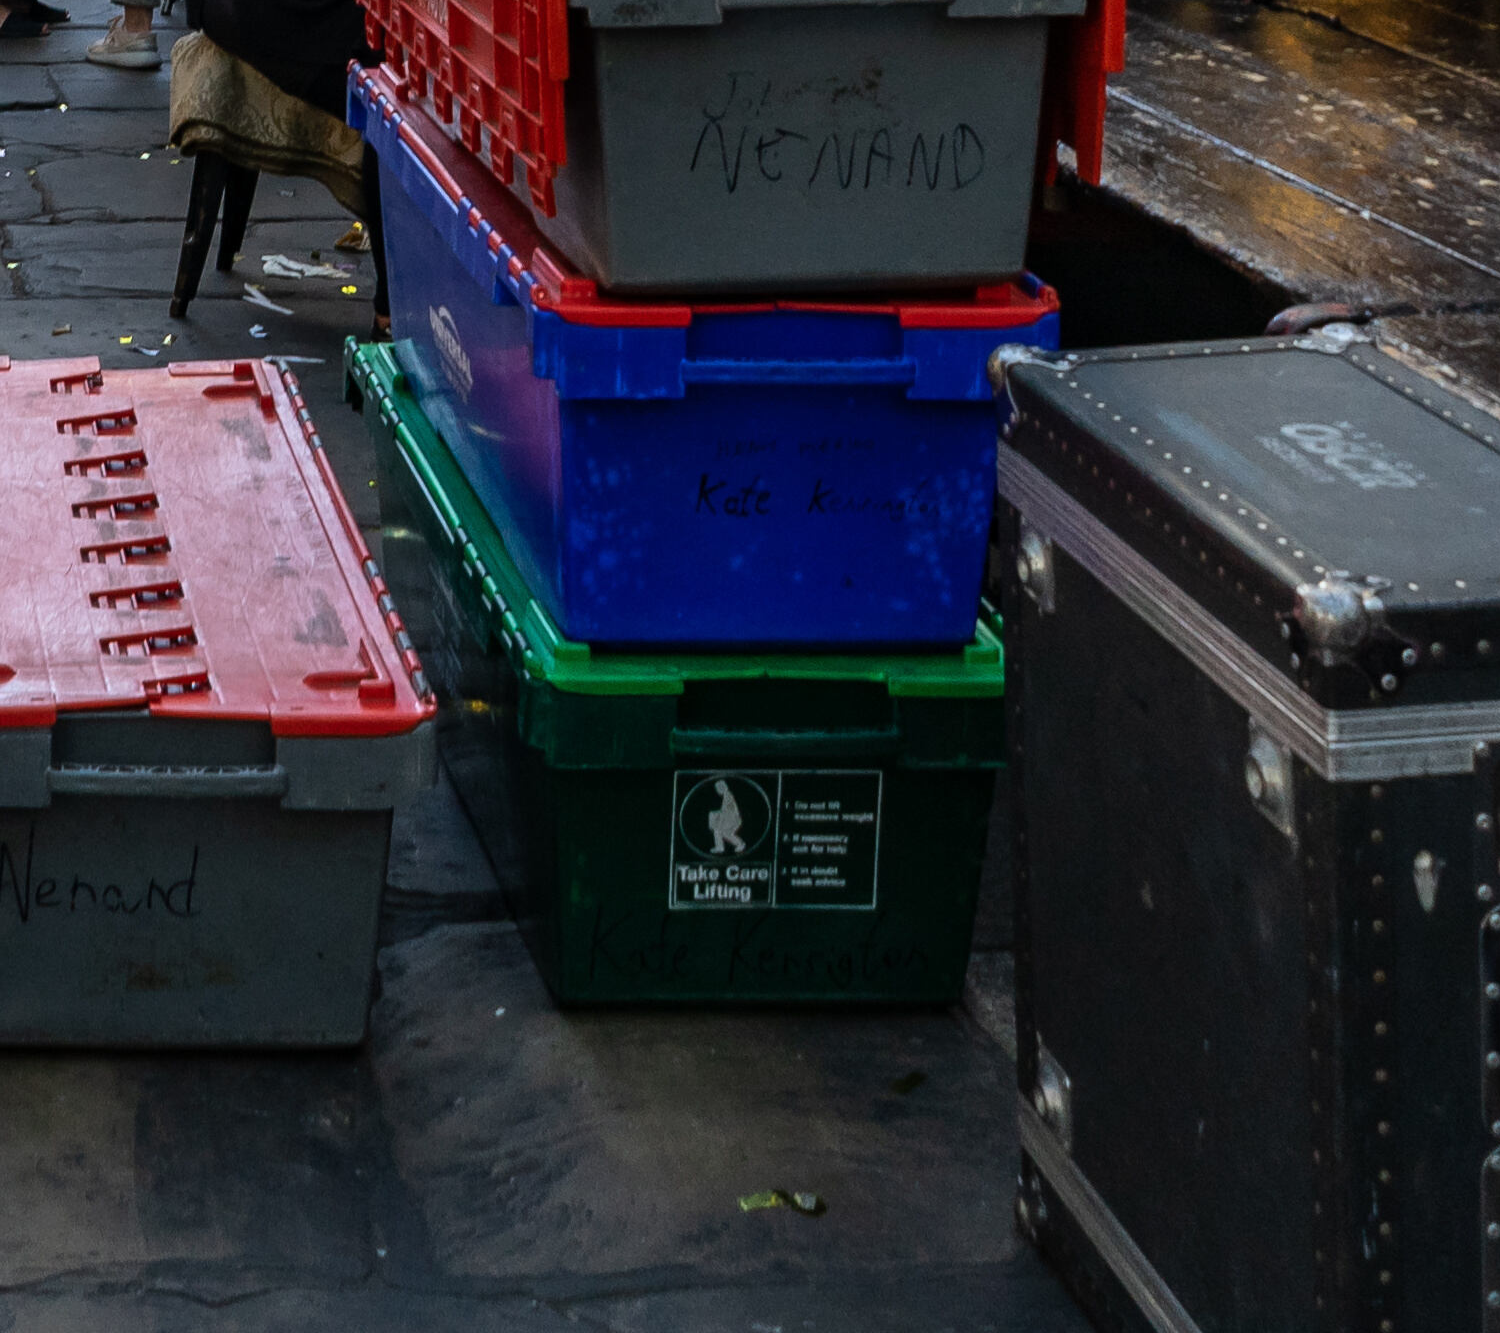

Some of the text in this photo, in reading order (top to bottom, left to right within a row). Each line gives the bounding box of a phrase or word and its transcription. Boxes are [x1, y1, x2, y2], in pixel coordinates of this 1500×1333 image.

[695, 473, 772, 518] Kate
[678, 864, 769, 883] Take Care
[693, 883, 752, 903] Lifting
